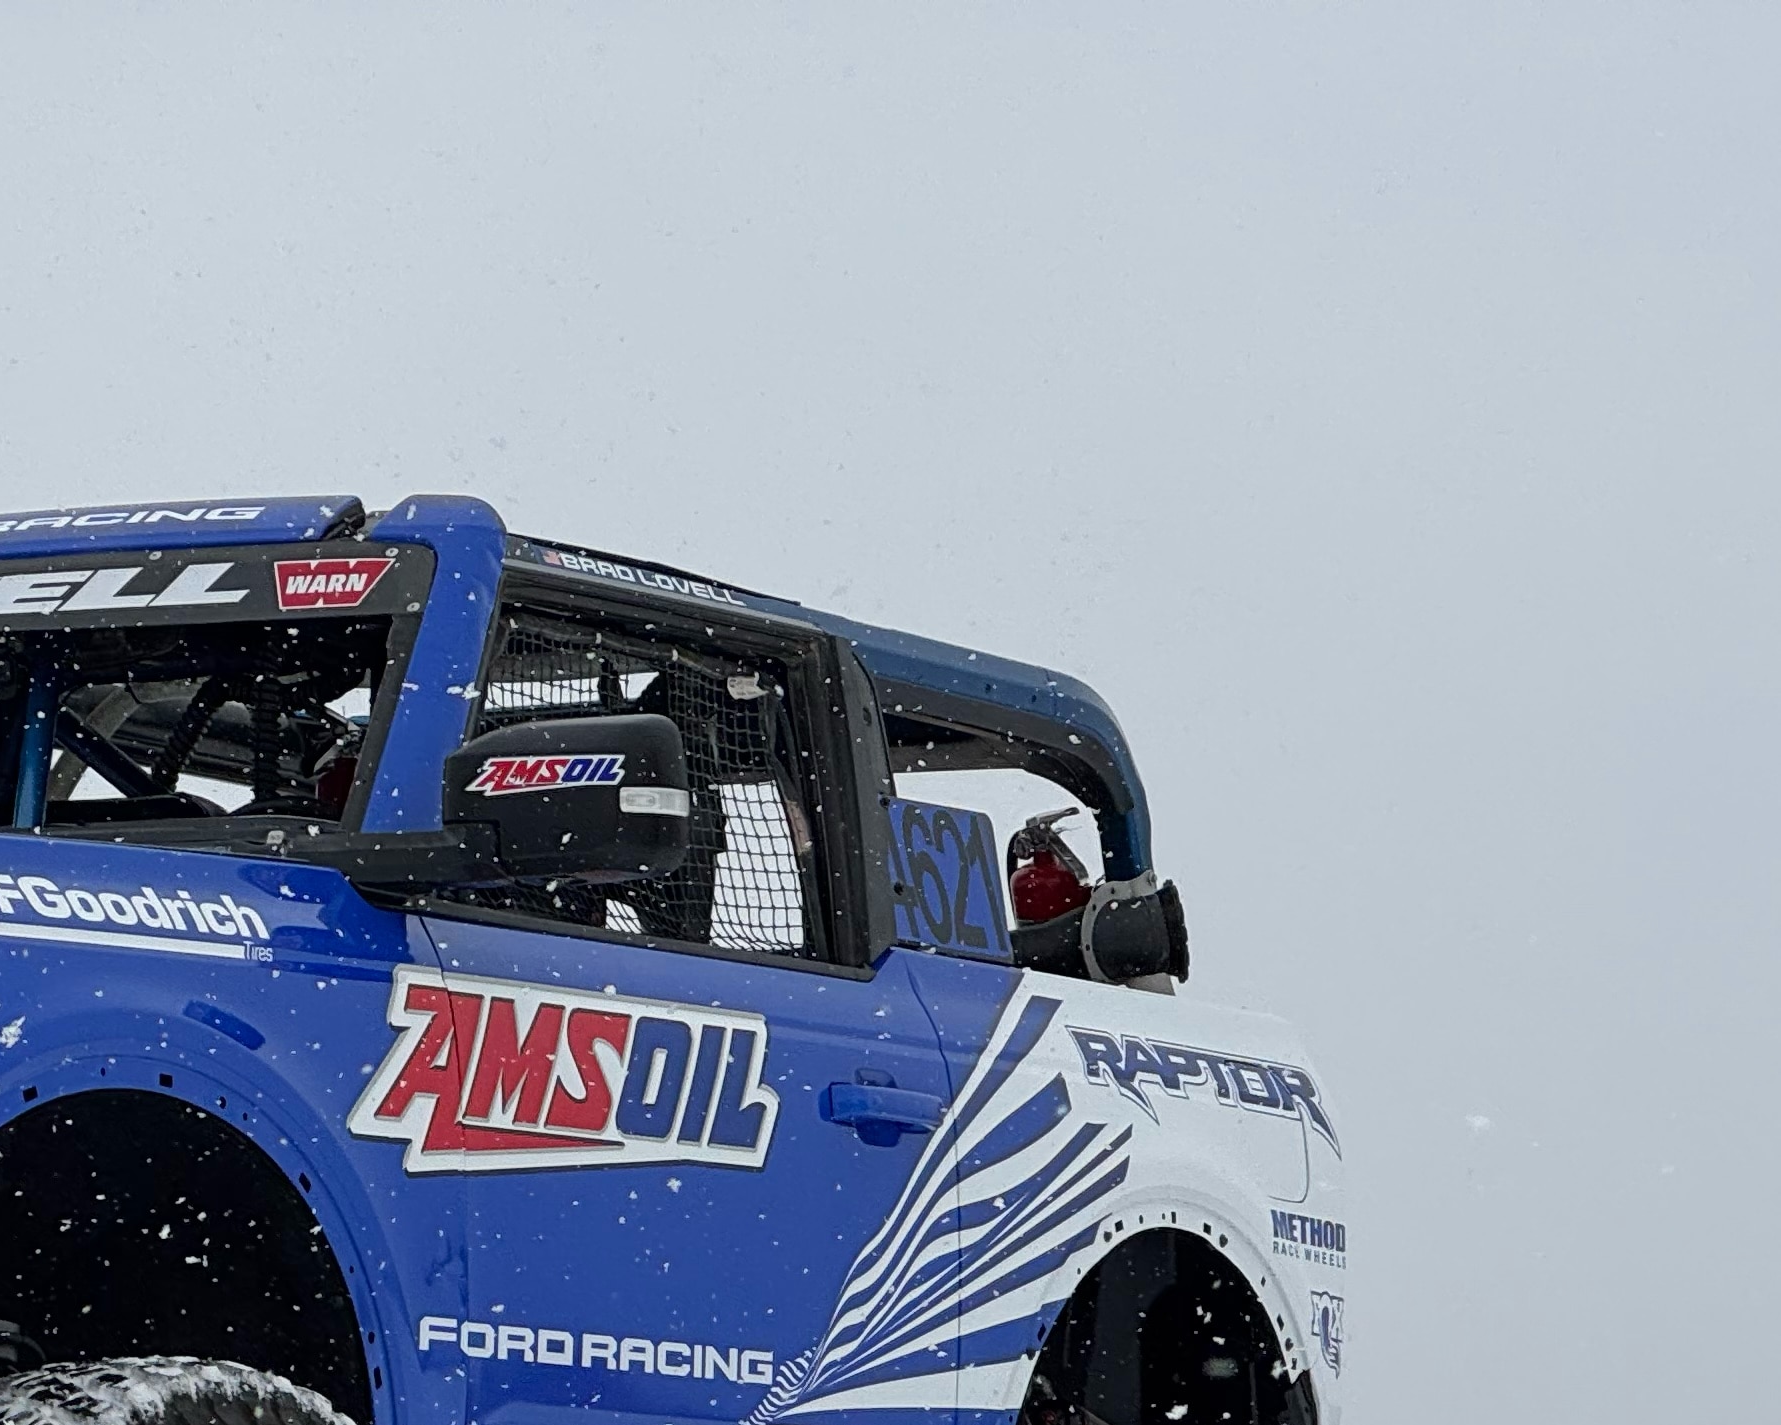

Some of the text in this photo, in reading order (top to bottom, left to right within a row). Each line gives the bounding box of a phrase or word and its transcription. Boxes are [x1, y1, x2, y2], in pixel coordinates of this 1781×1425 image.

[286, 573, 369, 595] WARN
[559, 553, 747, 607] BRAD LOVELL
[475, 757, 622, 792] AMSOIL
[243, 940, 274, 963] Tires
[374, 983, 768, 1154] AMSOIL
[1065, 1025, 1342, 1162] RAPTOR
[1270, 1209, 1346, 1253] METHOD
[1272, 1241, 1347, 1270] RACE WHEELS
[418, 1315, 774, 1386] FORD RACING
